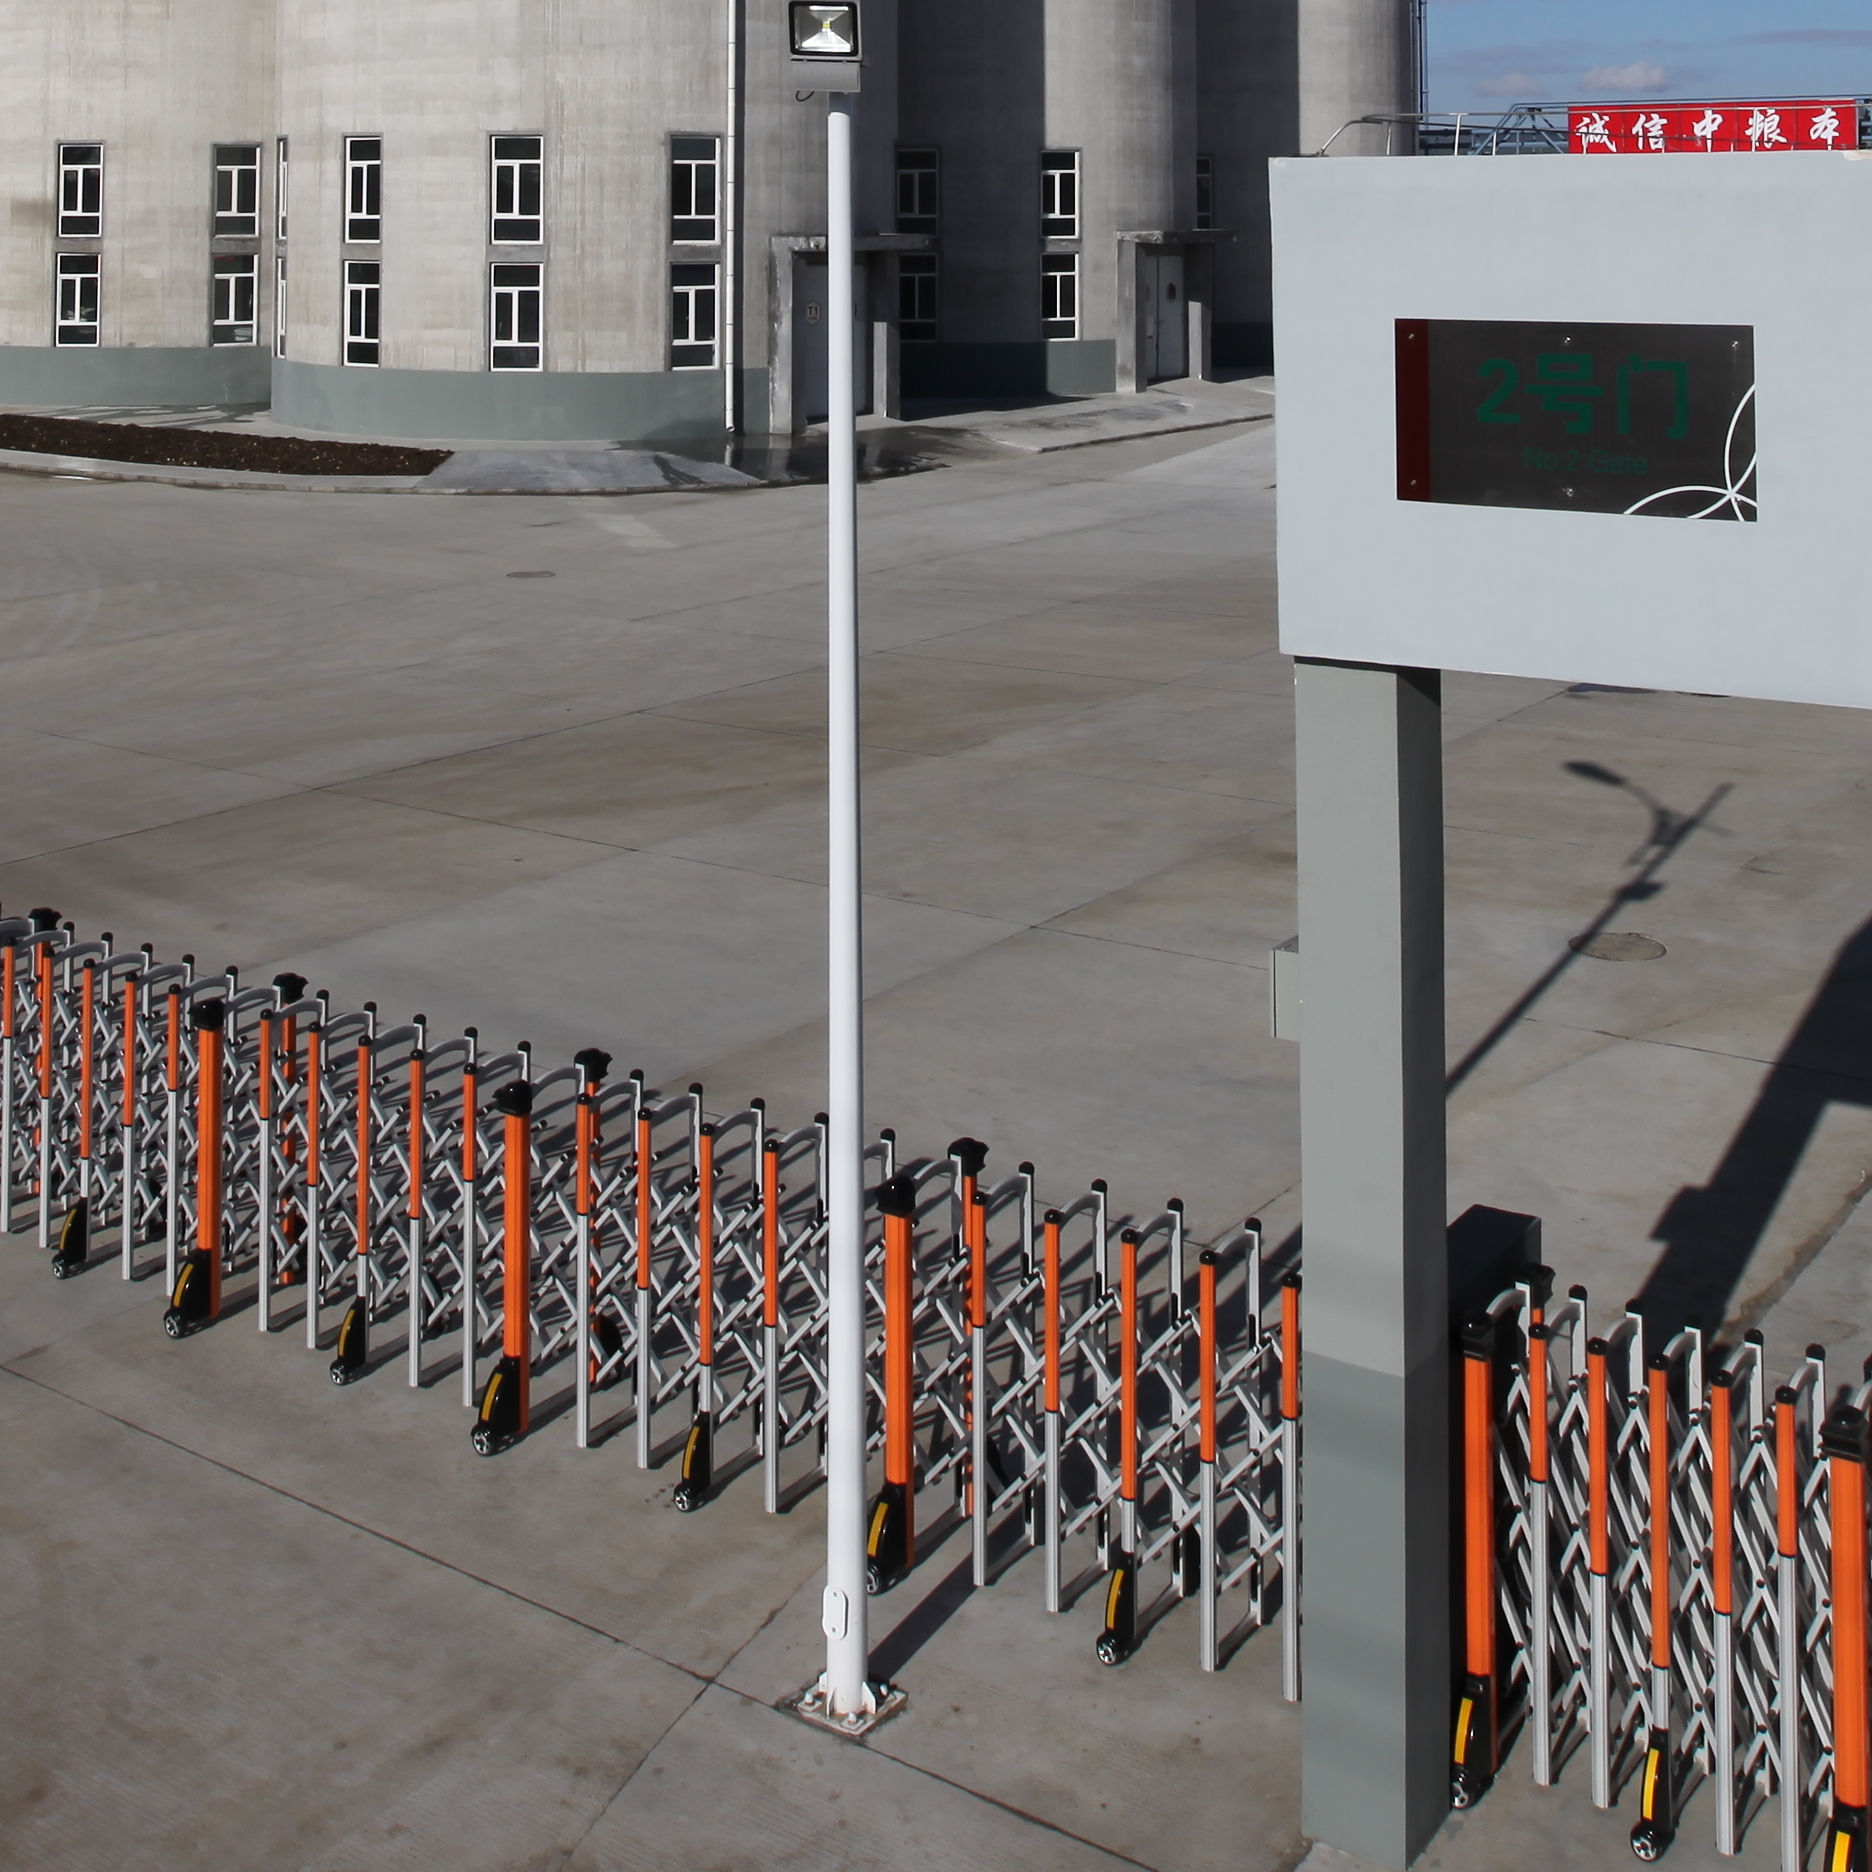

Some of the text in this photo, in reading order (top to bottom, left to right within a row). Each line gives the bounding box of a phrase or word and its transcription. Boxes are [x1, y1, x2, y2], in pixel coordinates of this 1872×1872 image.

[1477, 353, 1688, 439] 2号门
[1524, 447, 1649, 475] No.2 Gate
